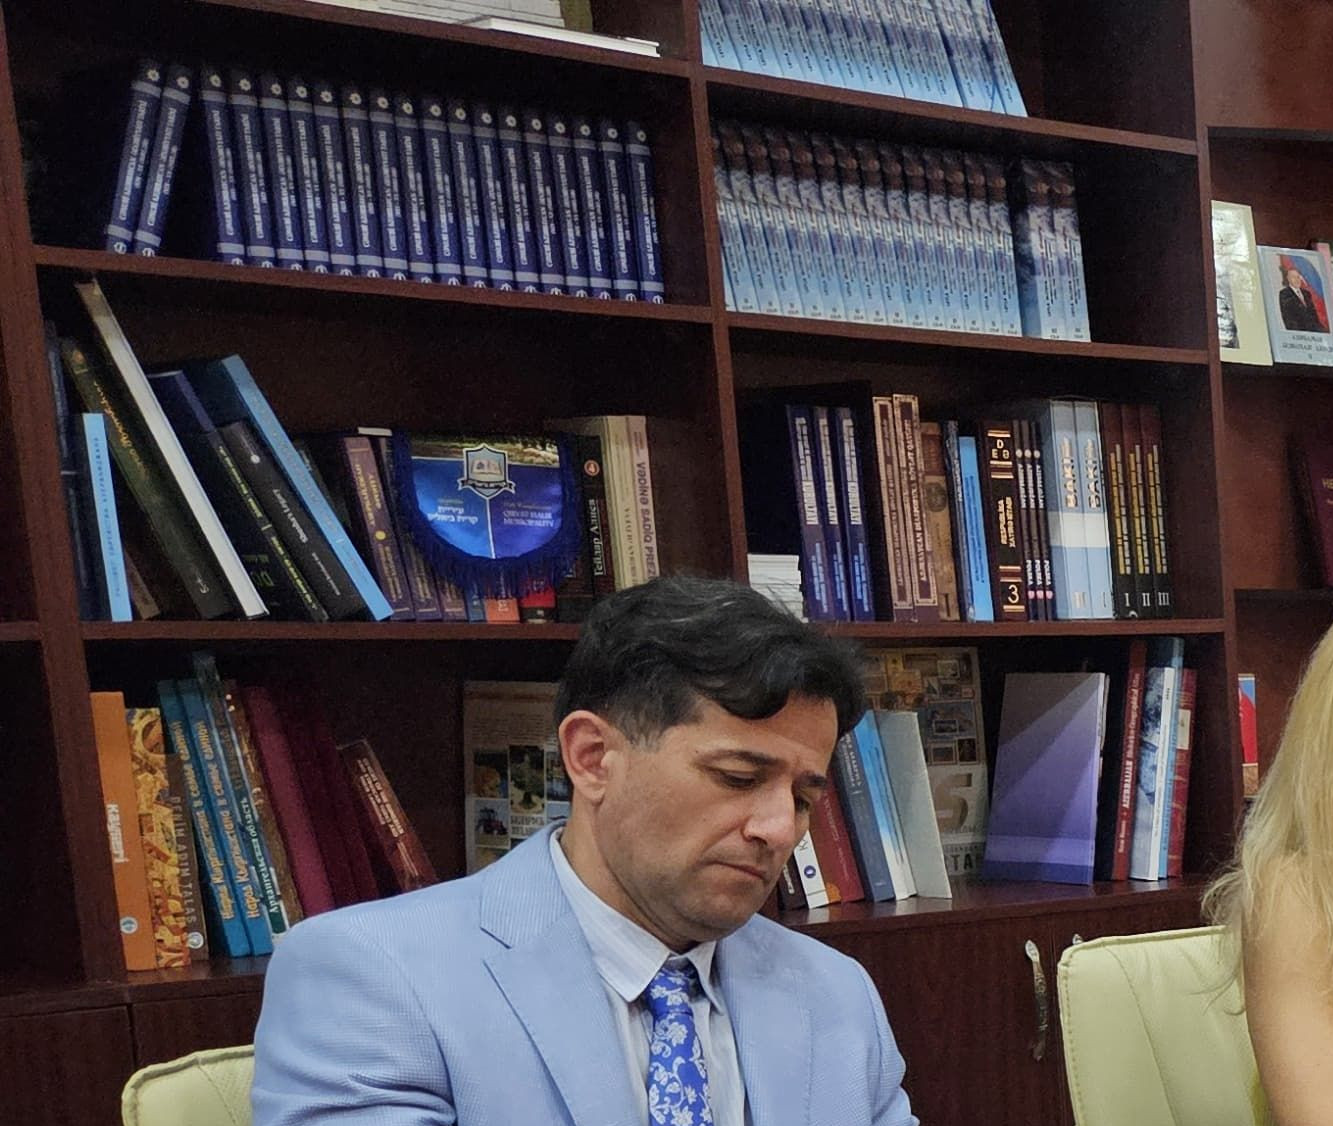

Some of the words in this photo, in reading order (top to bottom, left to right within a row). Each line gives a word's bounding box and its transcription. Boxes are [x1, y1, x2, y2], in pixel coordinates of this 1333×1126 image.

[1008, 584, 1020, 604] 3
[1158, 592, 1170, 607] III
[241, 796, 257, 837] область
